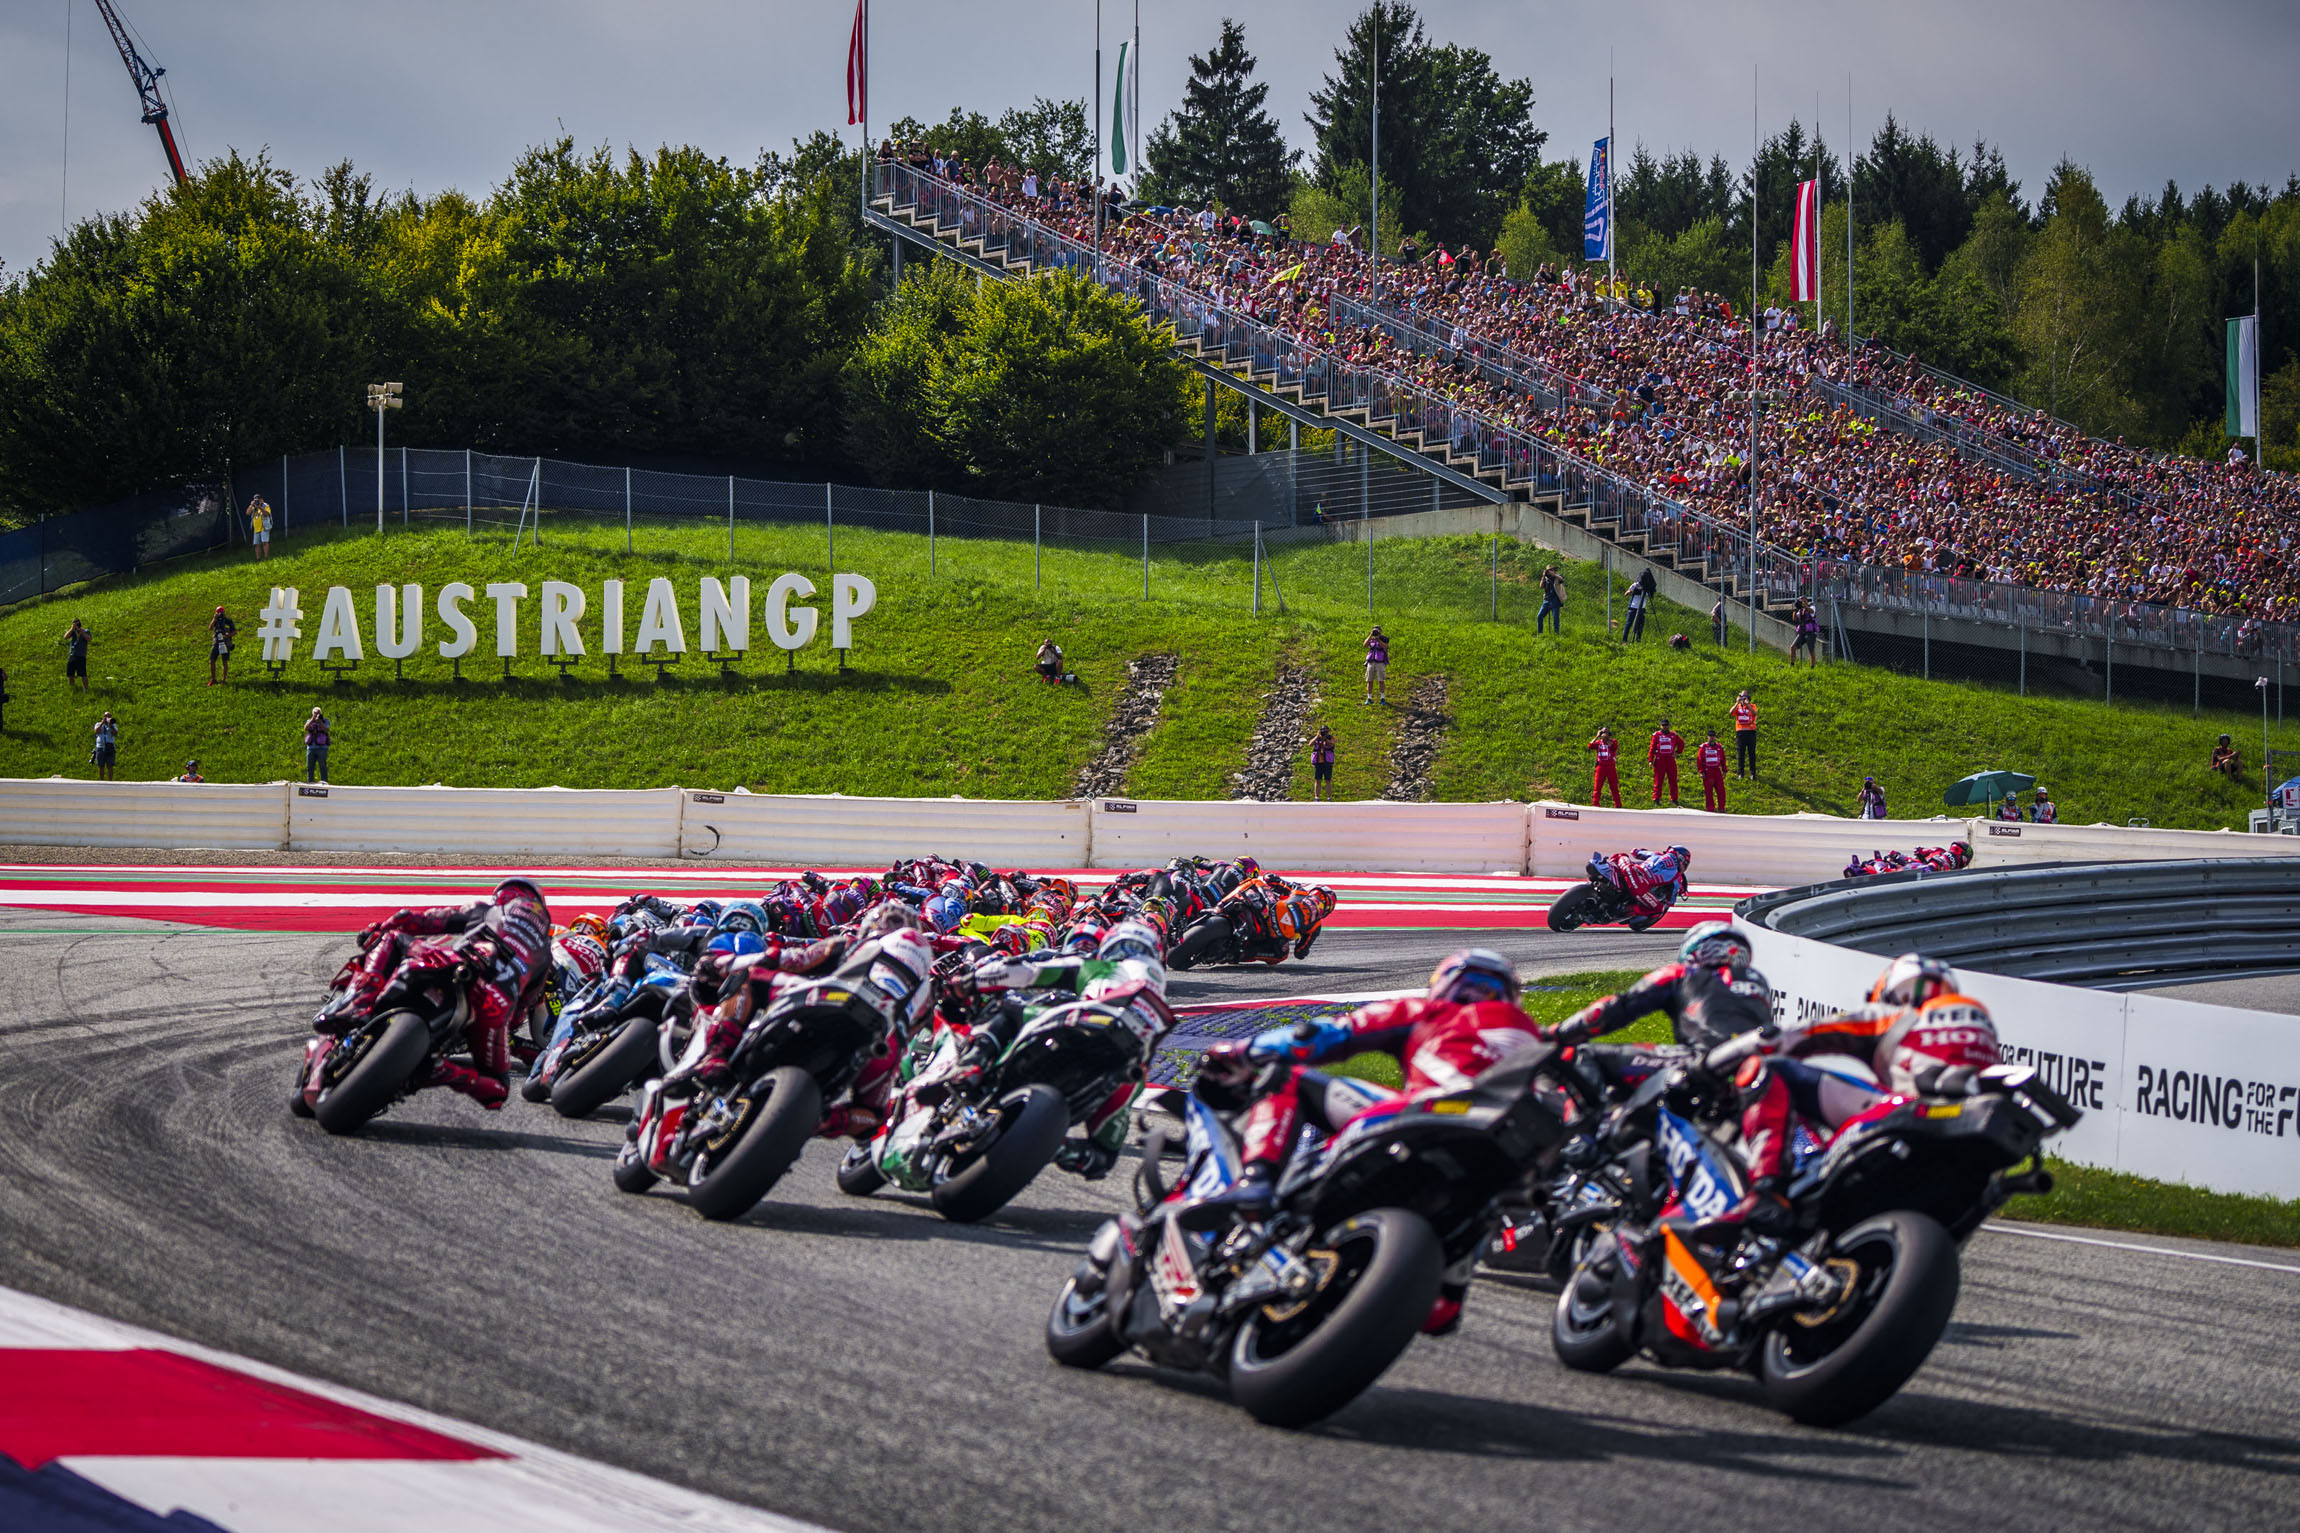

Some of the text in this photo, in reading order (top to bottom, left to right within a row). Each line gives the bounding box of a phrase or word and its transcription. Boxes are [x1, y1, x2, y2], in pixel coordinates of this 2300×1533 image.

[257, 572, 877, 662] #AUSTRIANGP
[729, 914, 753, 931] 25
[2136, 1064, 2243, 1130] RACING
[2246, 1081, 2276, 1108] FOR
[2246, 1108, 2274, 1136] THE
[1658, 1112, 1729, 1219] HODA
